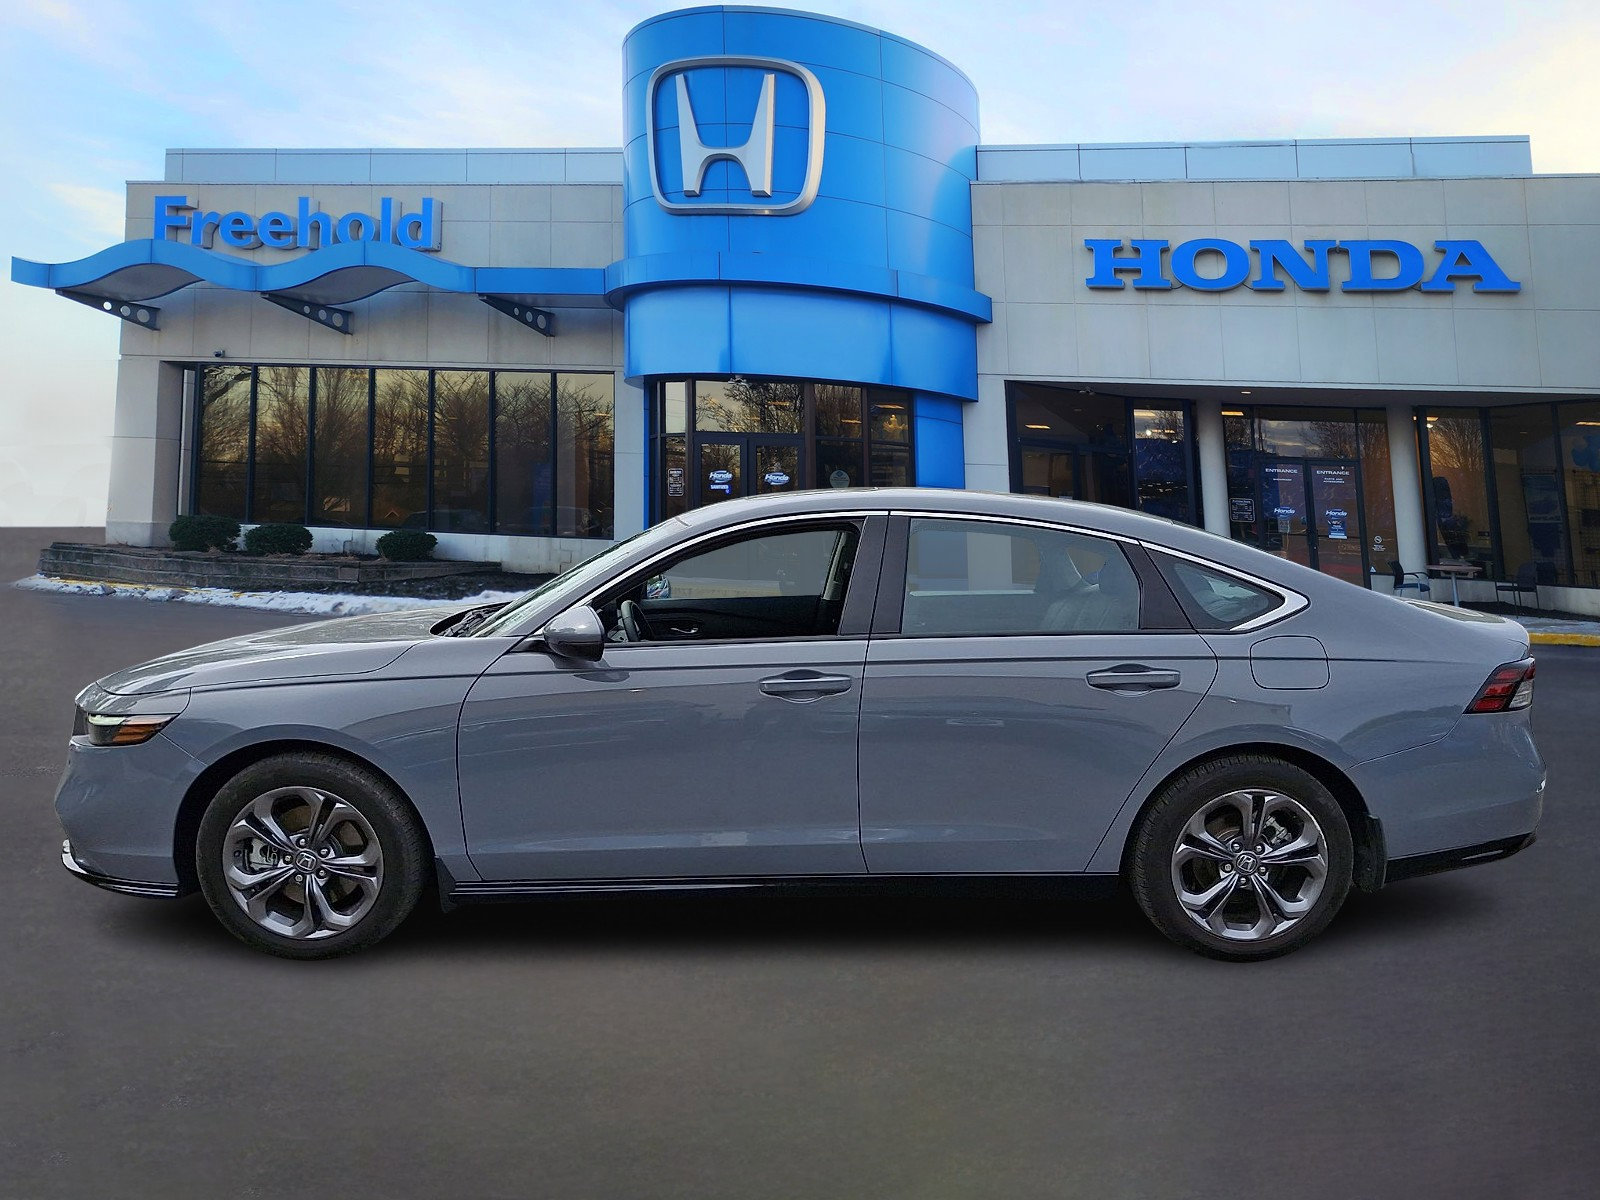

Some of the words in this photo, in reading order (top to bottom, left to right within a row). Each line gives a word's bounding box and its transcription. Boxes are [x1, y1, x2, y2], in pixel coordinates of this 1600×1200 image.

[153, 195, 441, 250] Freehold
[1084, 238, 1521, 293] HONDA
[1274, 507, 1296, 515] Honda
